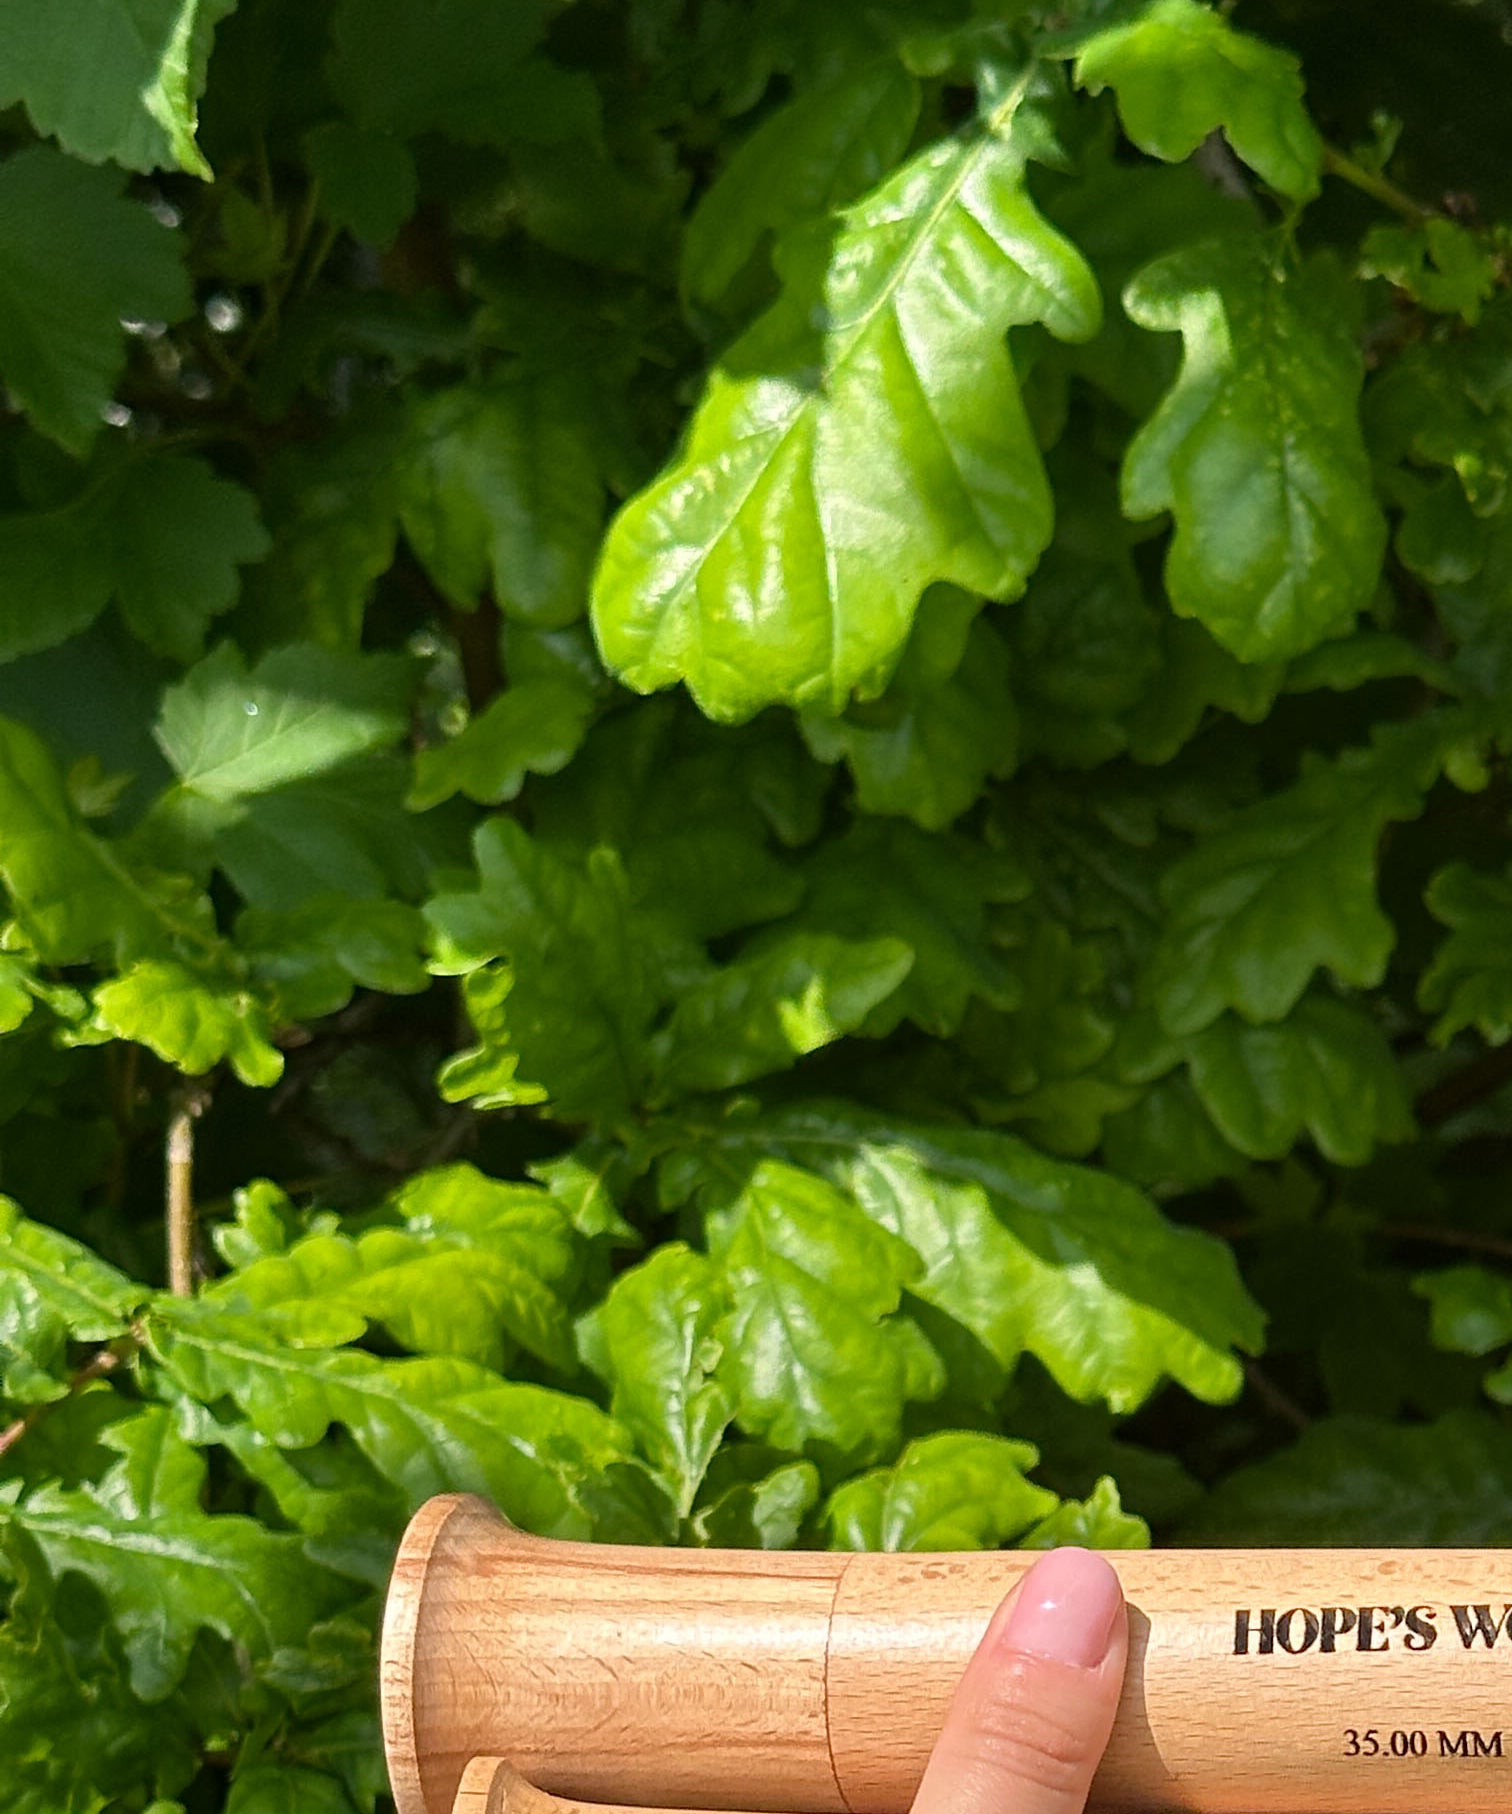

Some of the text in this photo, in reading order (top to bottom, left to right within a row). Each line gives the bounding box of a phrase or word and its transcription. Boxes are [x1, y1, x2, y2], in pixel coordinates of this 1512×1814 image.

[1233, 1604, 1438, 1655] HOPE'S
[1343, 1728, 1506, 1759] 35.00 MM
